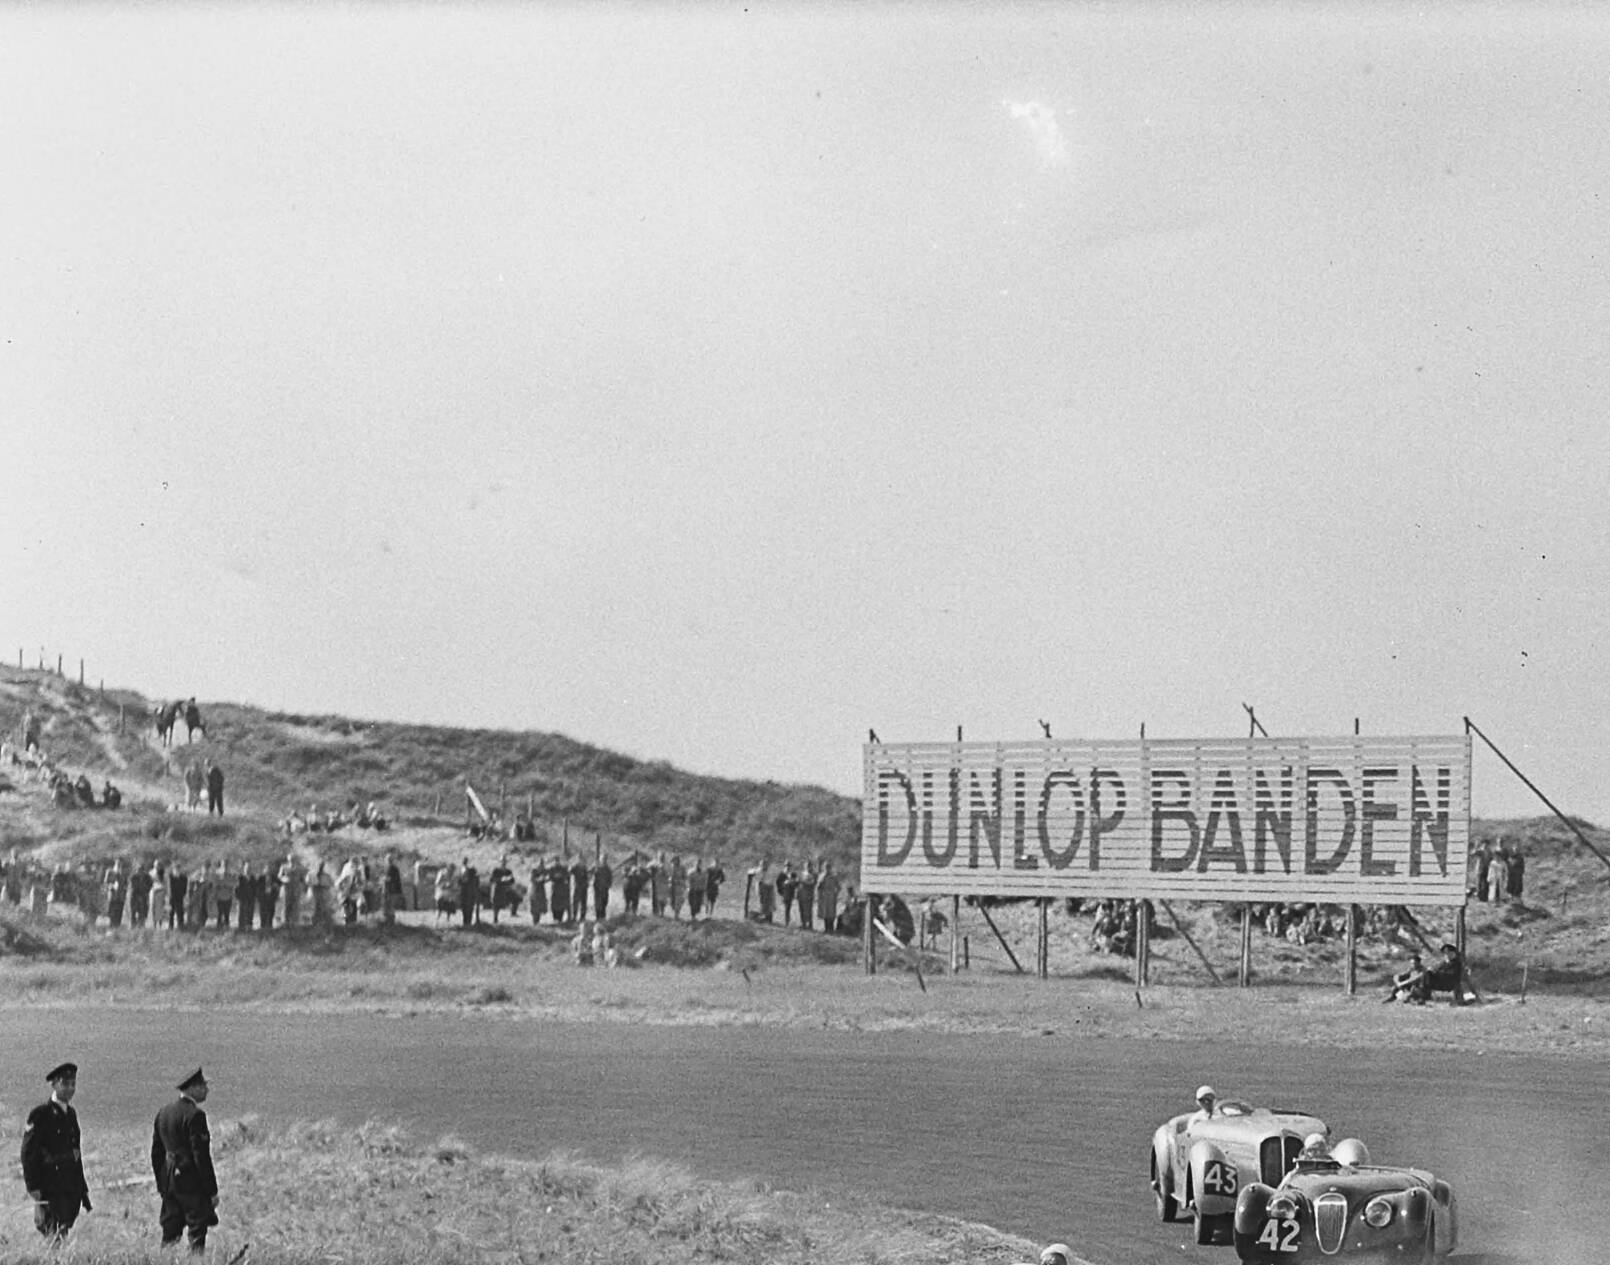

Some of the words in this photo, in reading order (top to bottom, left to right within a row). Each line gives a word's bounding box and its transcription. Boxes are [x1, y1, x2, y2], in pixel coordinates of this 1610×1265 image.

[877, 767, 1126, 871] DUNLOP
[1150, 765, 1450, 877] BANDEN
[1203, 1163, 1237, 1194] 43
[1258, 1218, 1301, 1252] 42
